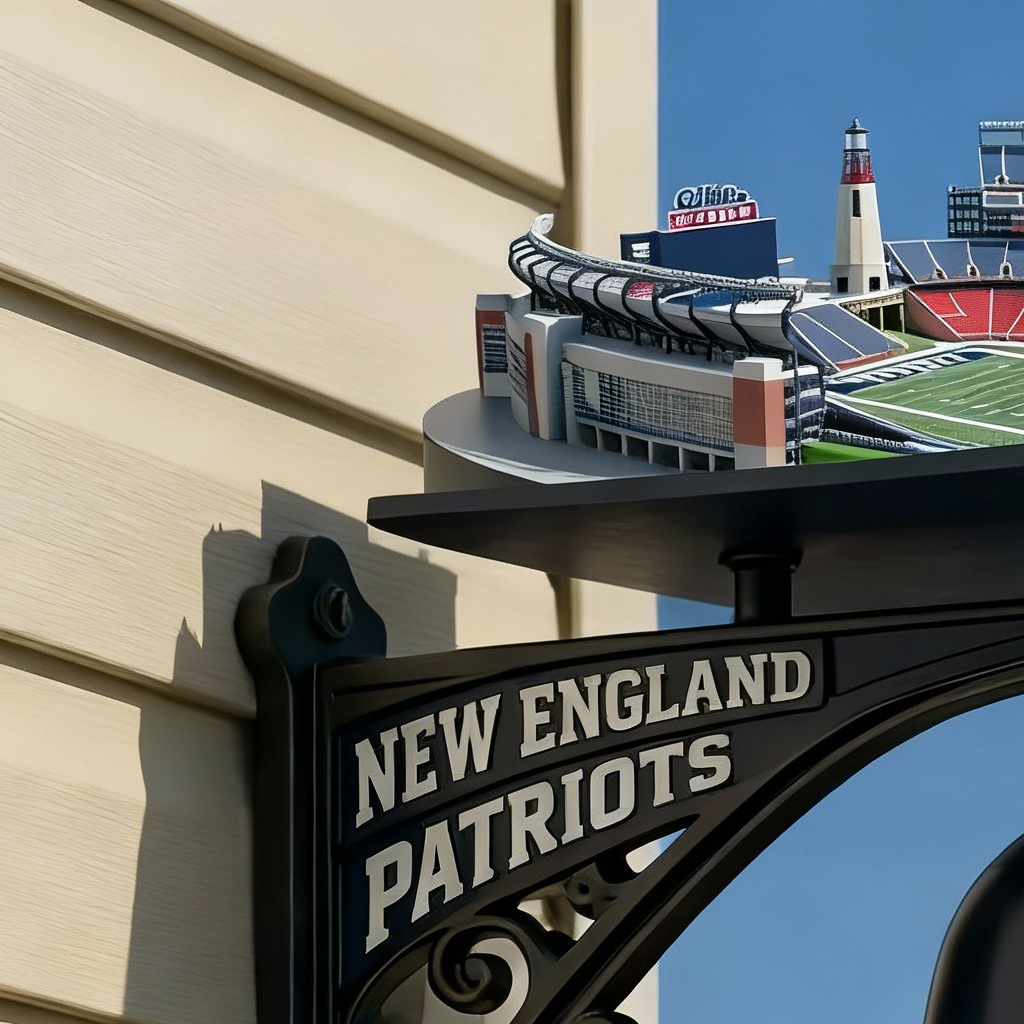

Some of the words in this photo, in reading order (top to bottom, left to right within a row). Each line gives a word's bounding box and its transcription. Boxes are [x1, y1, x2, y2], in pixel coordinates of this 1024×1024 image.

[354, 693, 502, 829] NEW
[519, 650, 812, 759] ENGLAND
[364, 732, 733, 955] PATRIOTS
